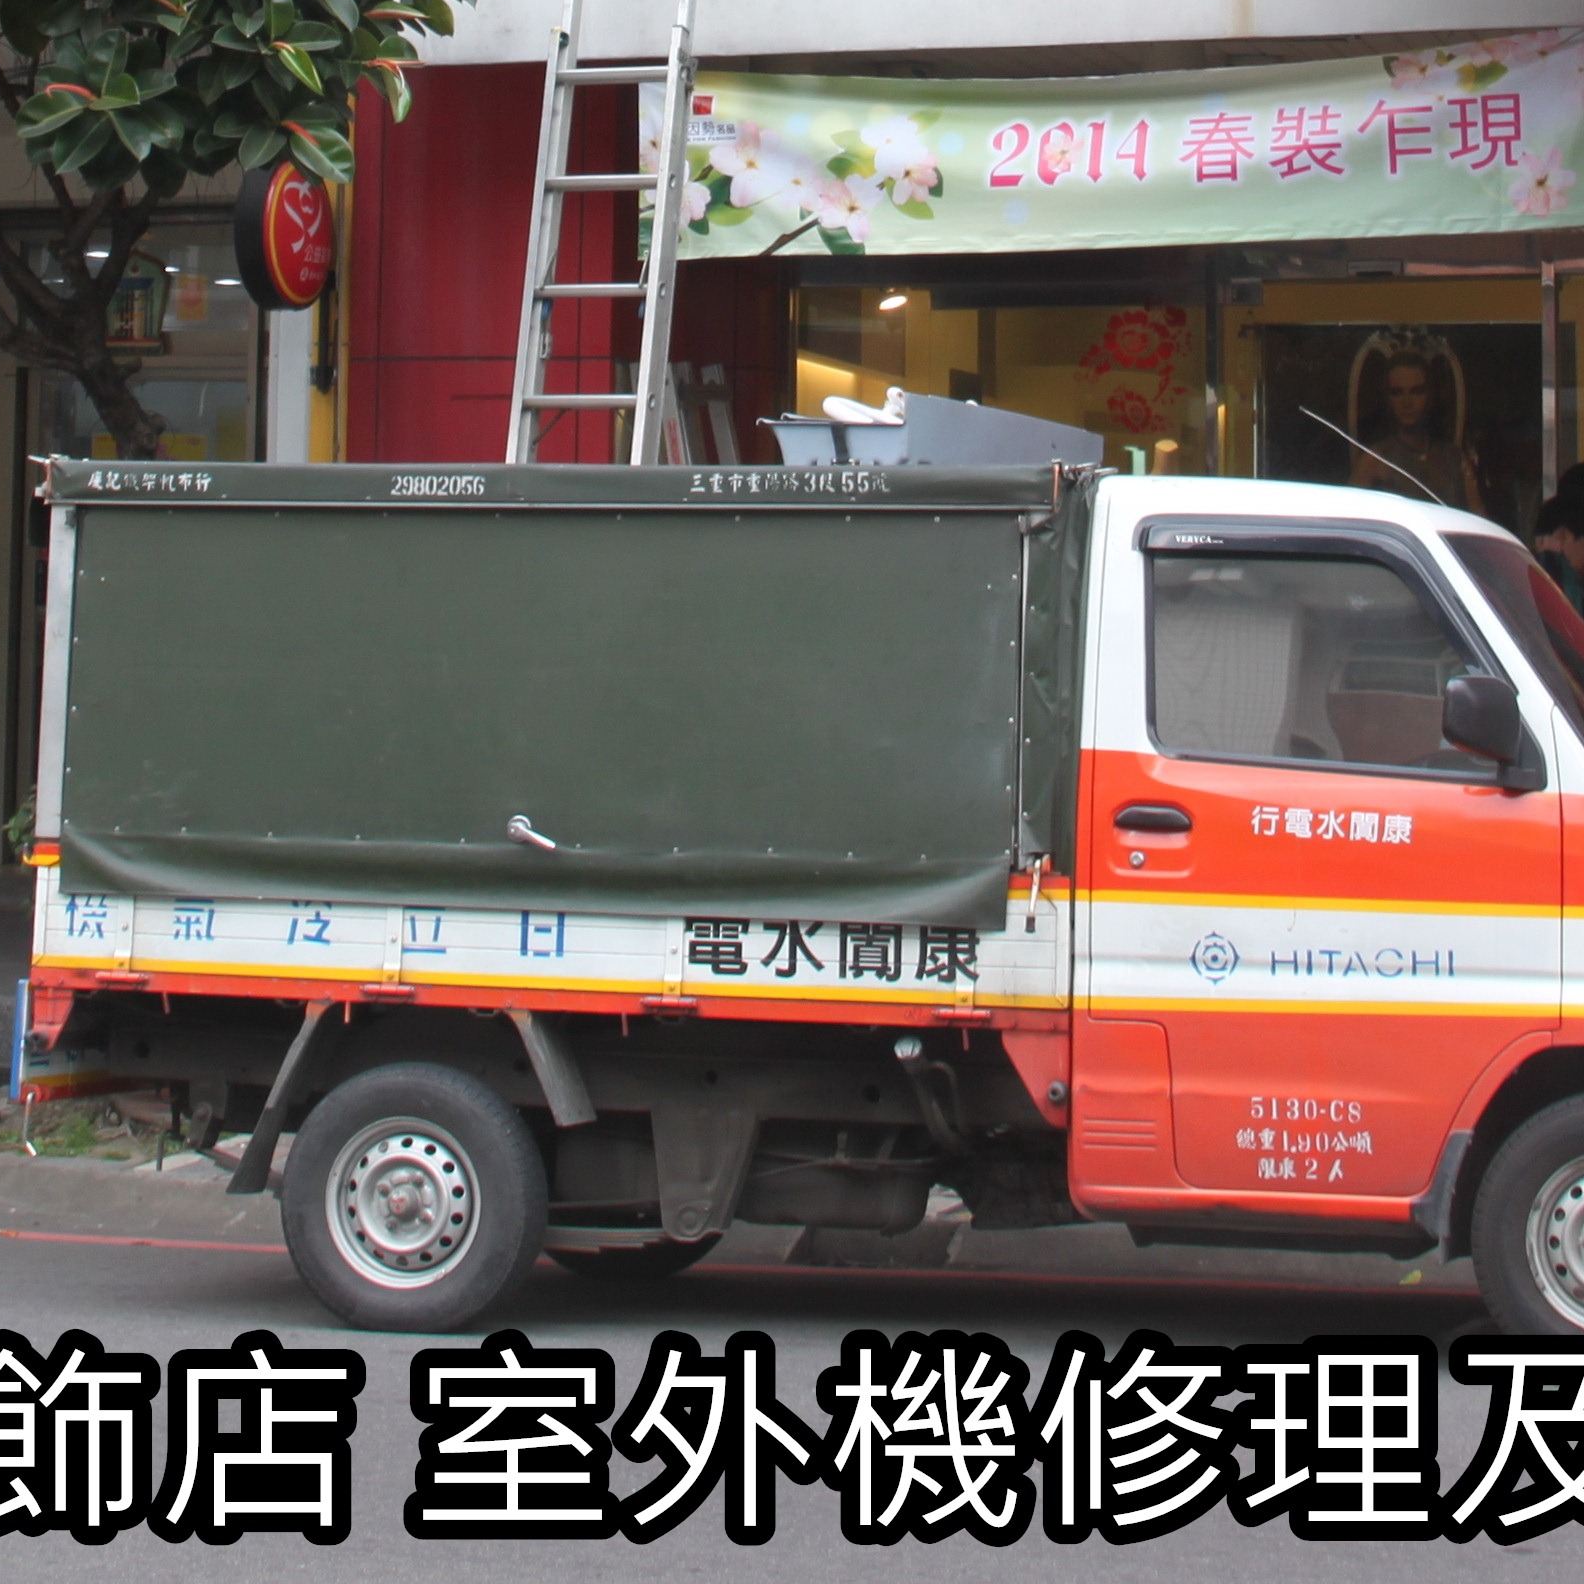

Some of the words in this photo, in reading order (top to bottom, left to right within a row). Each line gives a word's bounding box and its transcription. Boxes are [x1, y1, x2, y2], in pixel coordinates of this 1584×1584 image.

[990, 117, 1150, 188] 2014
[1179, 92, 1525, 184] 春裝乍現
[1270, 946, 1455, 980] HITACHI
